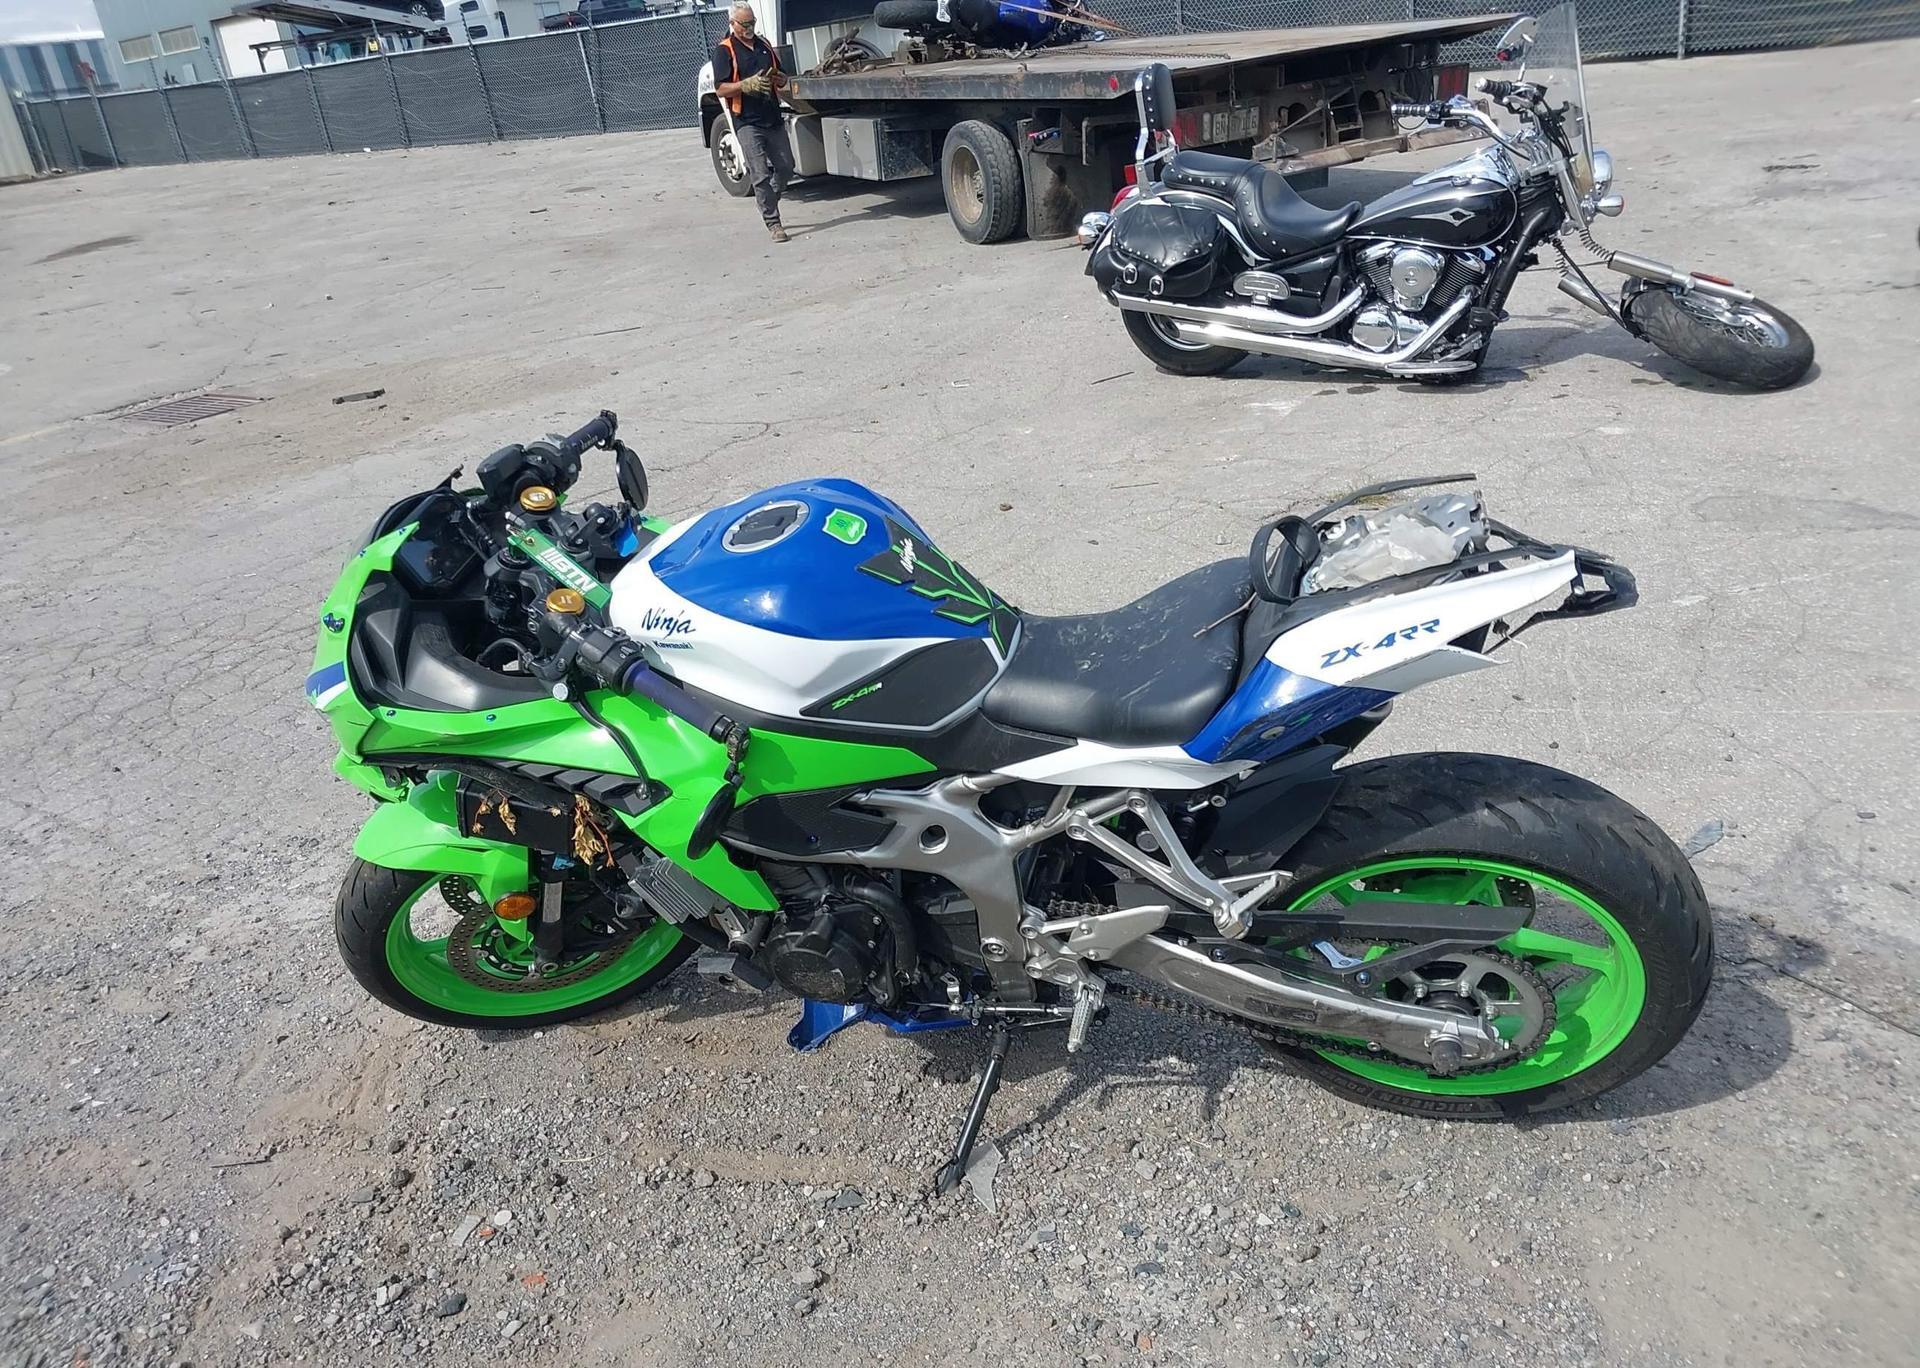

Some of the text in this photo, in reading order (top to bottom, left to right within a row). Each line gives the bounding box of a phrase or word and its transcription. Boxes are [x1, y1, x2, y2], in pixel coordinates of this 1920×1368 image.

[641, 608, 696, 640] Ninja
[652, 640, 694, 650] Kawasaki
[1320, 618, 1440, 669] ZX-4RR
